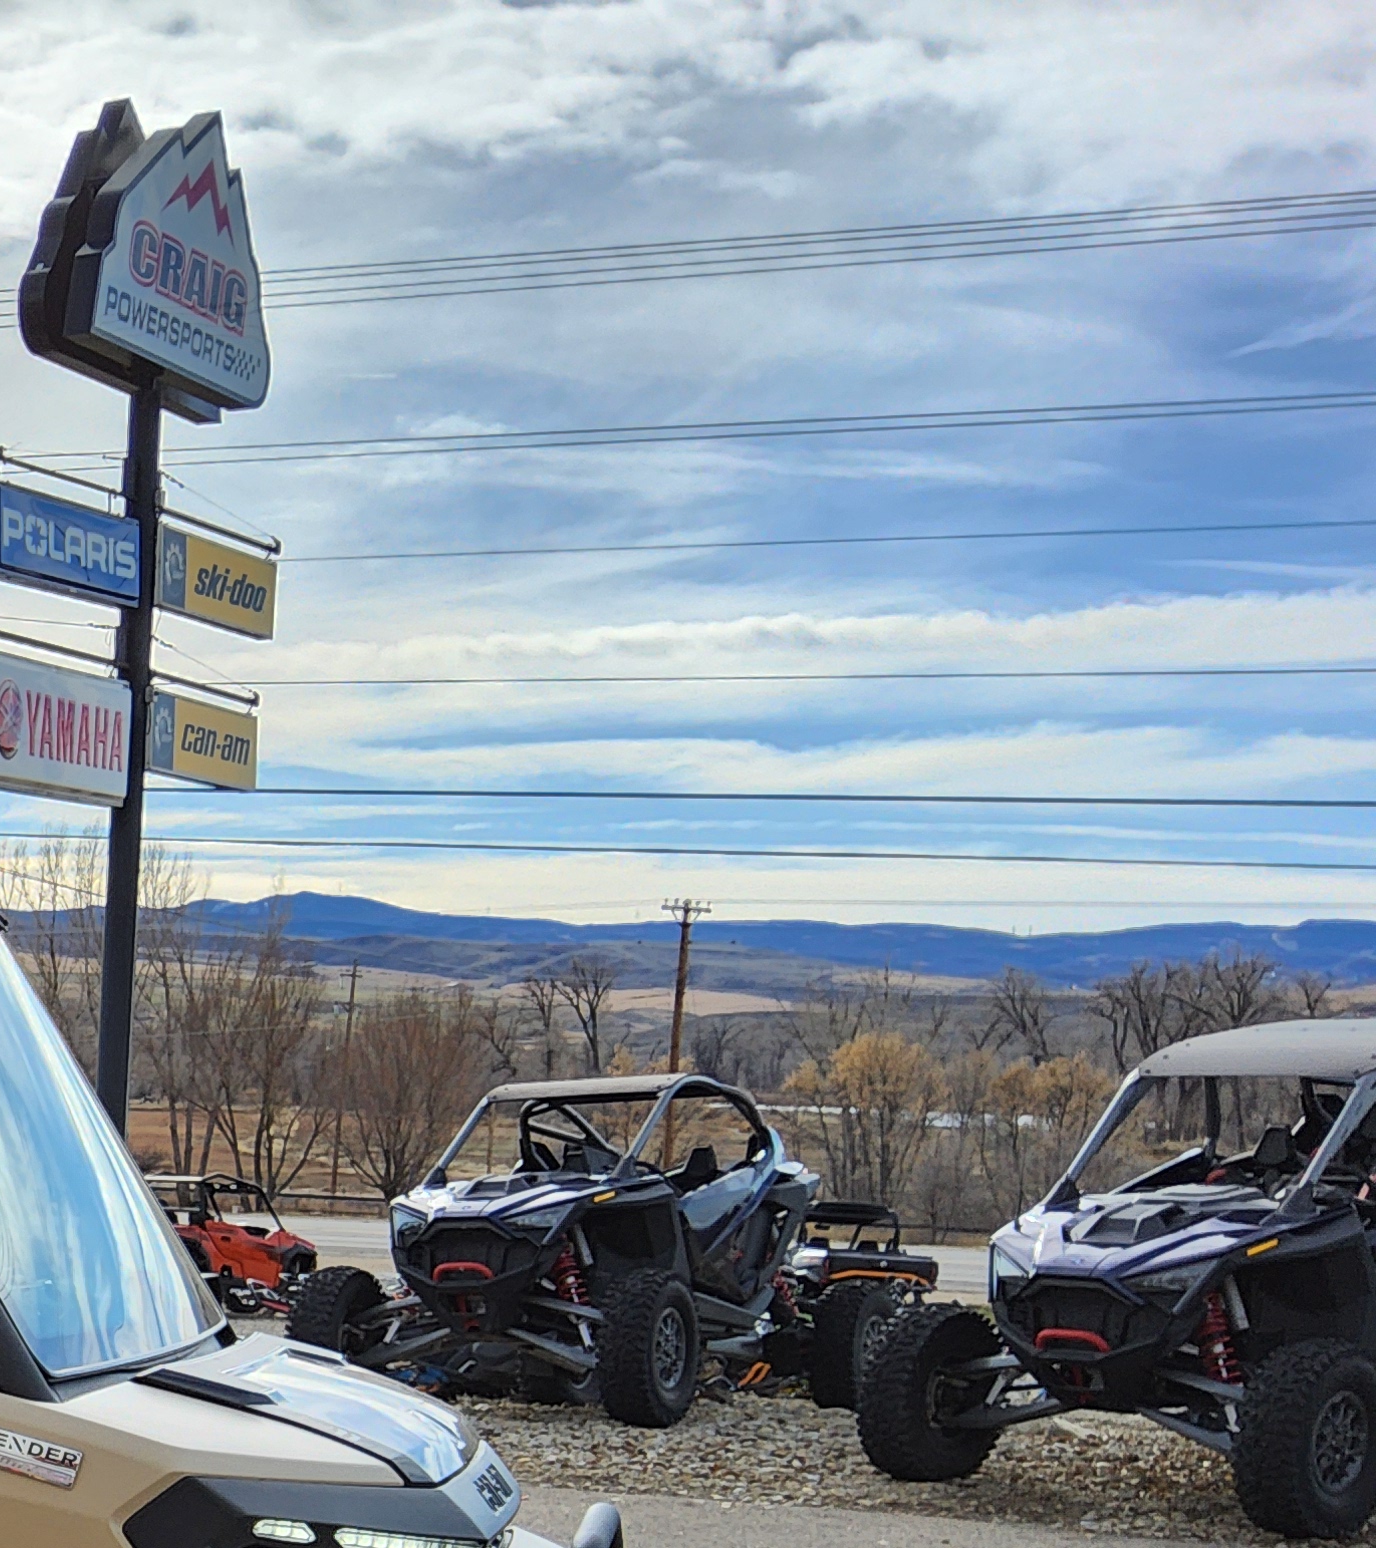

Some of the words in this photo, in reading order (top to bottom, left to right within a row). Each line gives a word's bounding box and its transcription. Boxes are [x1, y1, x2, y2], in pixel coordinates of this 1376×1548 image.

[129, 220, 247, 337] CRAIG
[106, 285, 235, 372] POWERSPORTS
[2, 509, 137, 579] POLARIS
[194, 564, 267, 612] ski-doo
[26, 689, 123, 773] YAMAHA
[181, 723, 251, 767] can-am
